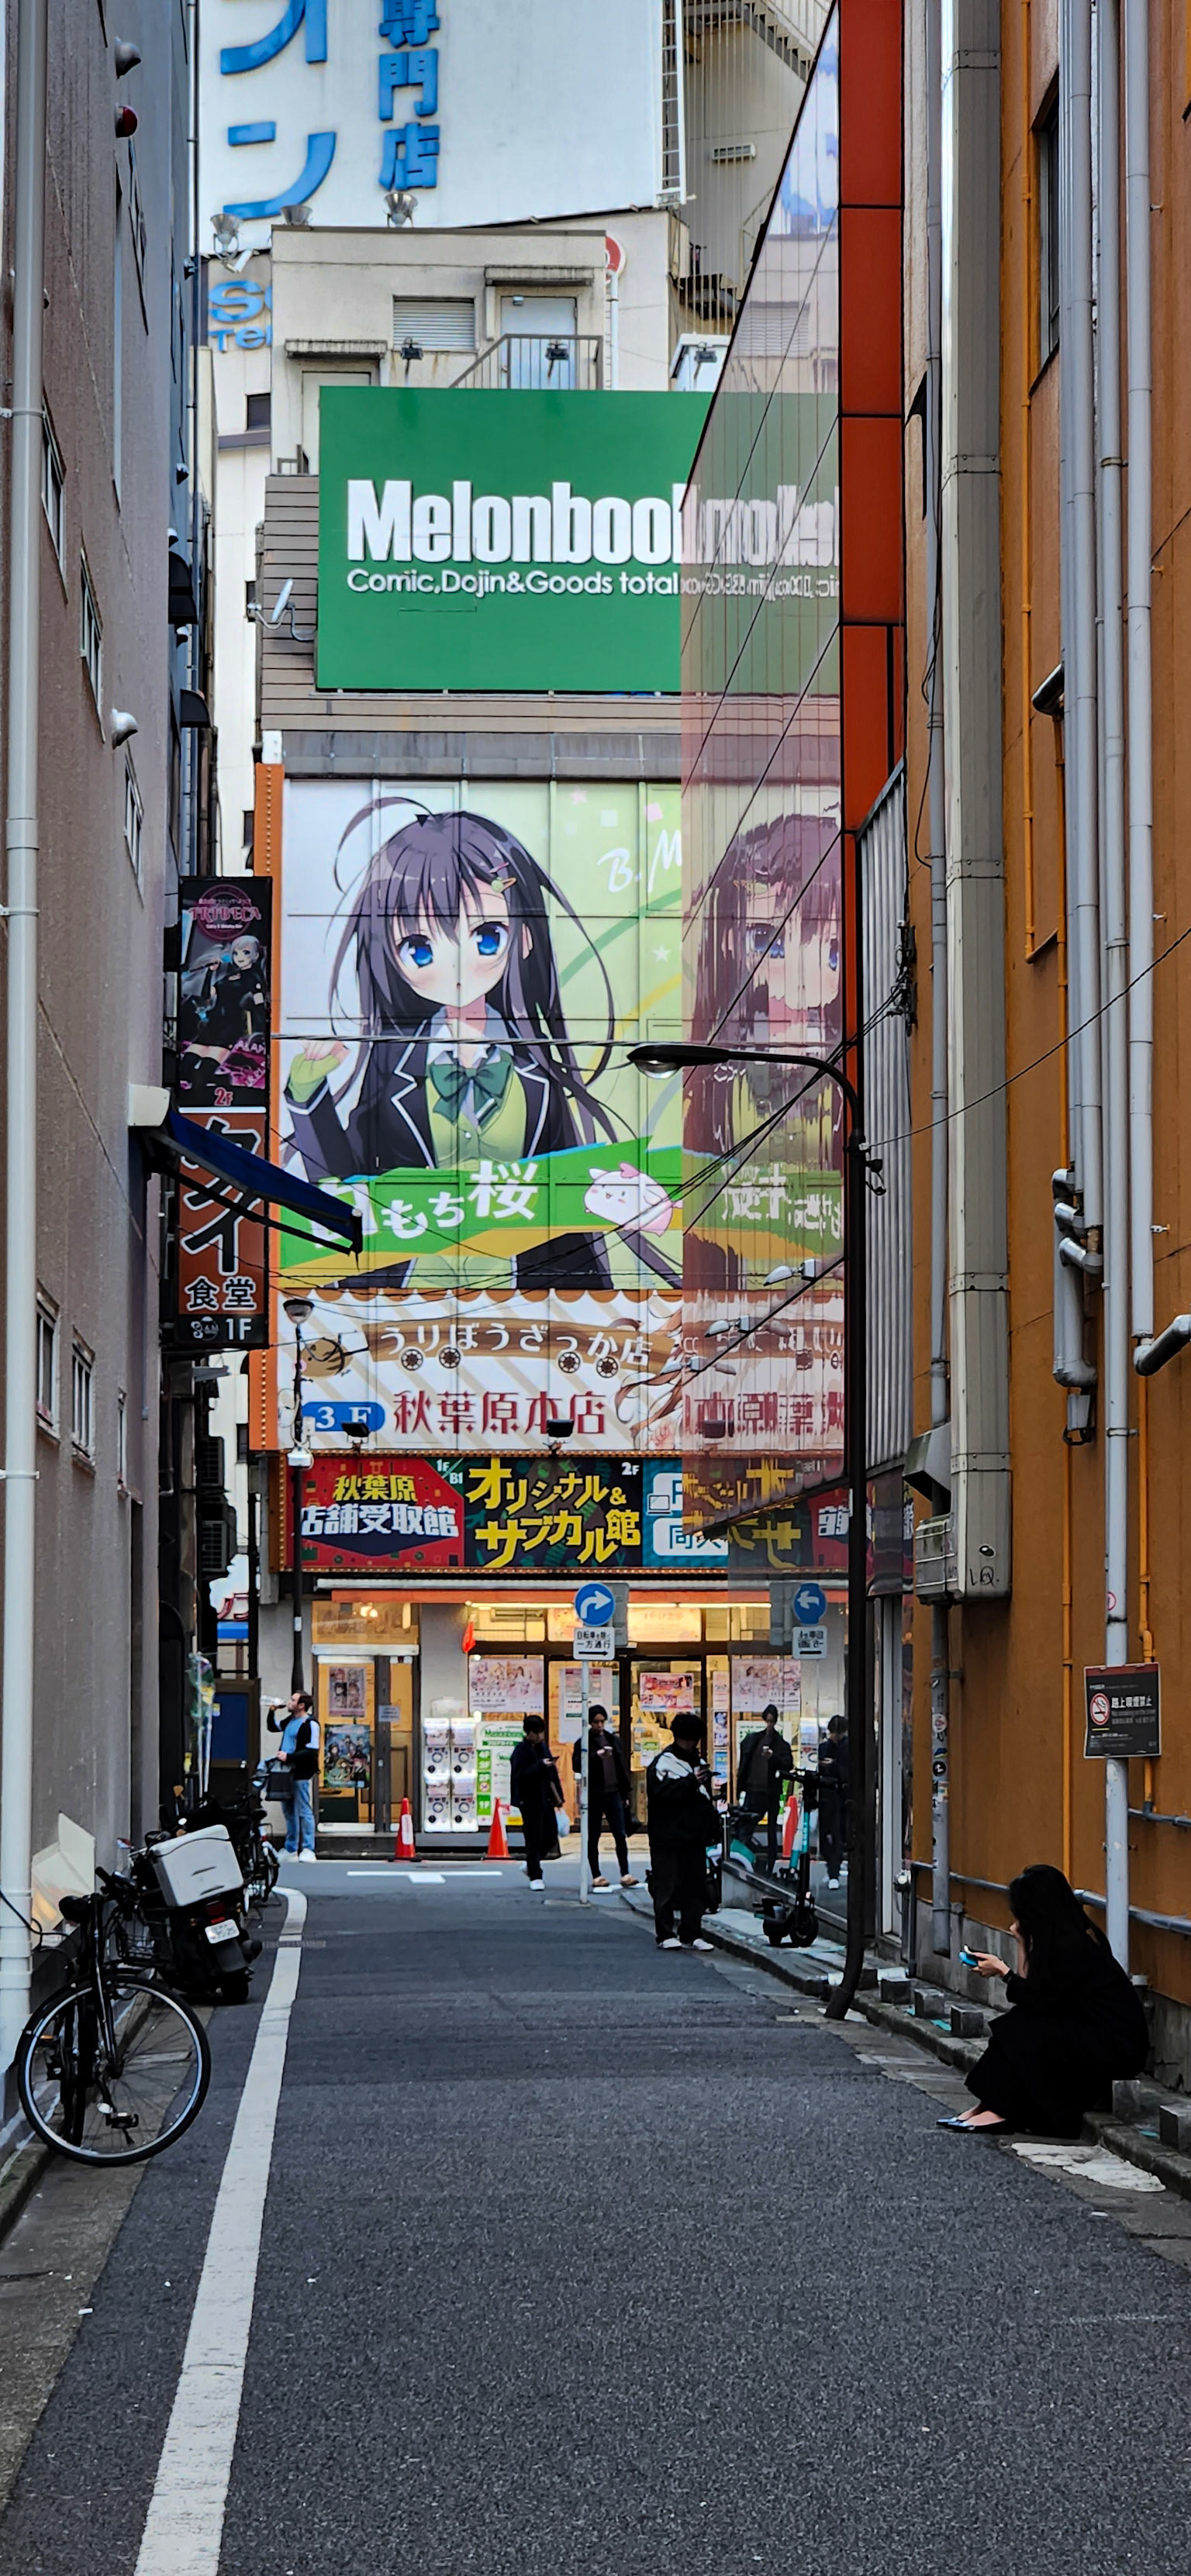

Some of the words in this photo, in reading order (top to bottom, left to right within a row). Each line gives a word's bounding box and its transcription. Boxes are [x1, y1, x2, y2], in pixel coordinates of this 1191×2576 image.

[620, 571, 679, 595] total
[214, 1087, 233, 1106] 2F
[185, 1275, 257, 1311] 食堂
[226, 1318, 252, 1340] 1F
[381, 1322, 653, 1366] うりぼうざっか店
[394, 1391, 605, 1434] 秋葉原本店
[621, 1462, 640, 1475] 2F
[332, 1474, 418, 1502] 秋葉原
[301, 1503, 459, 1537] 店舗受取館
[475, 1509, 641, 1568] サブカル館
